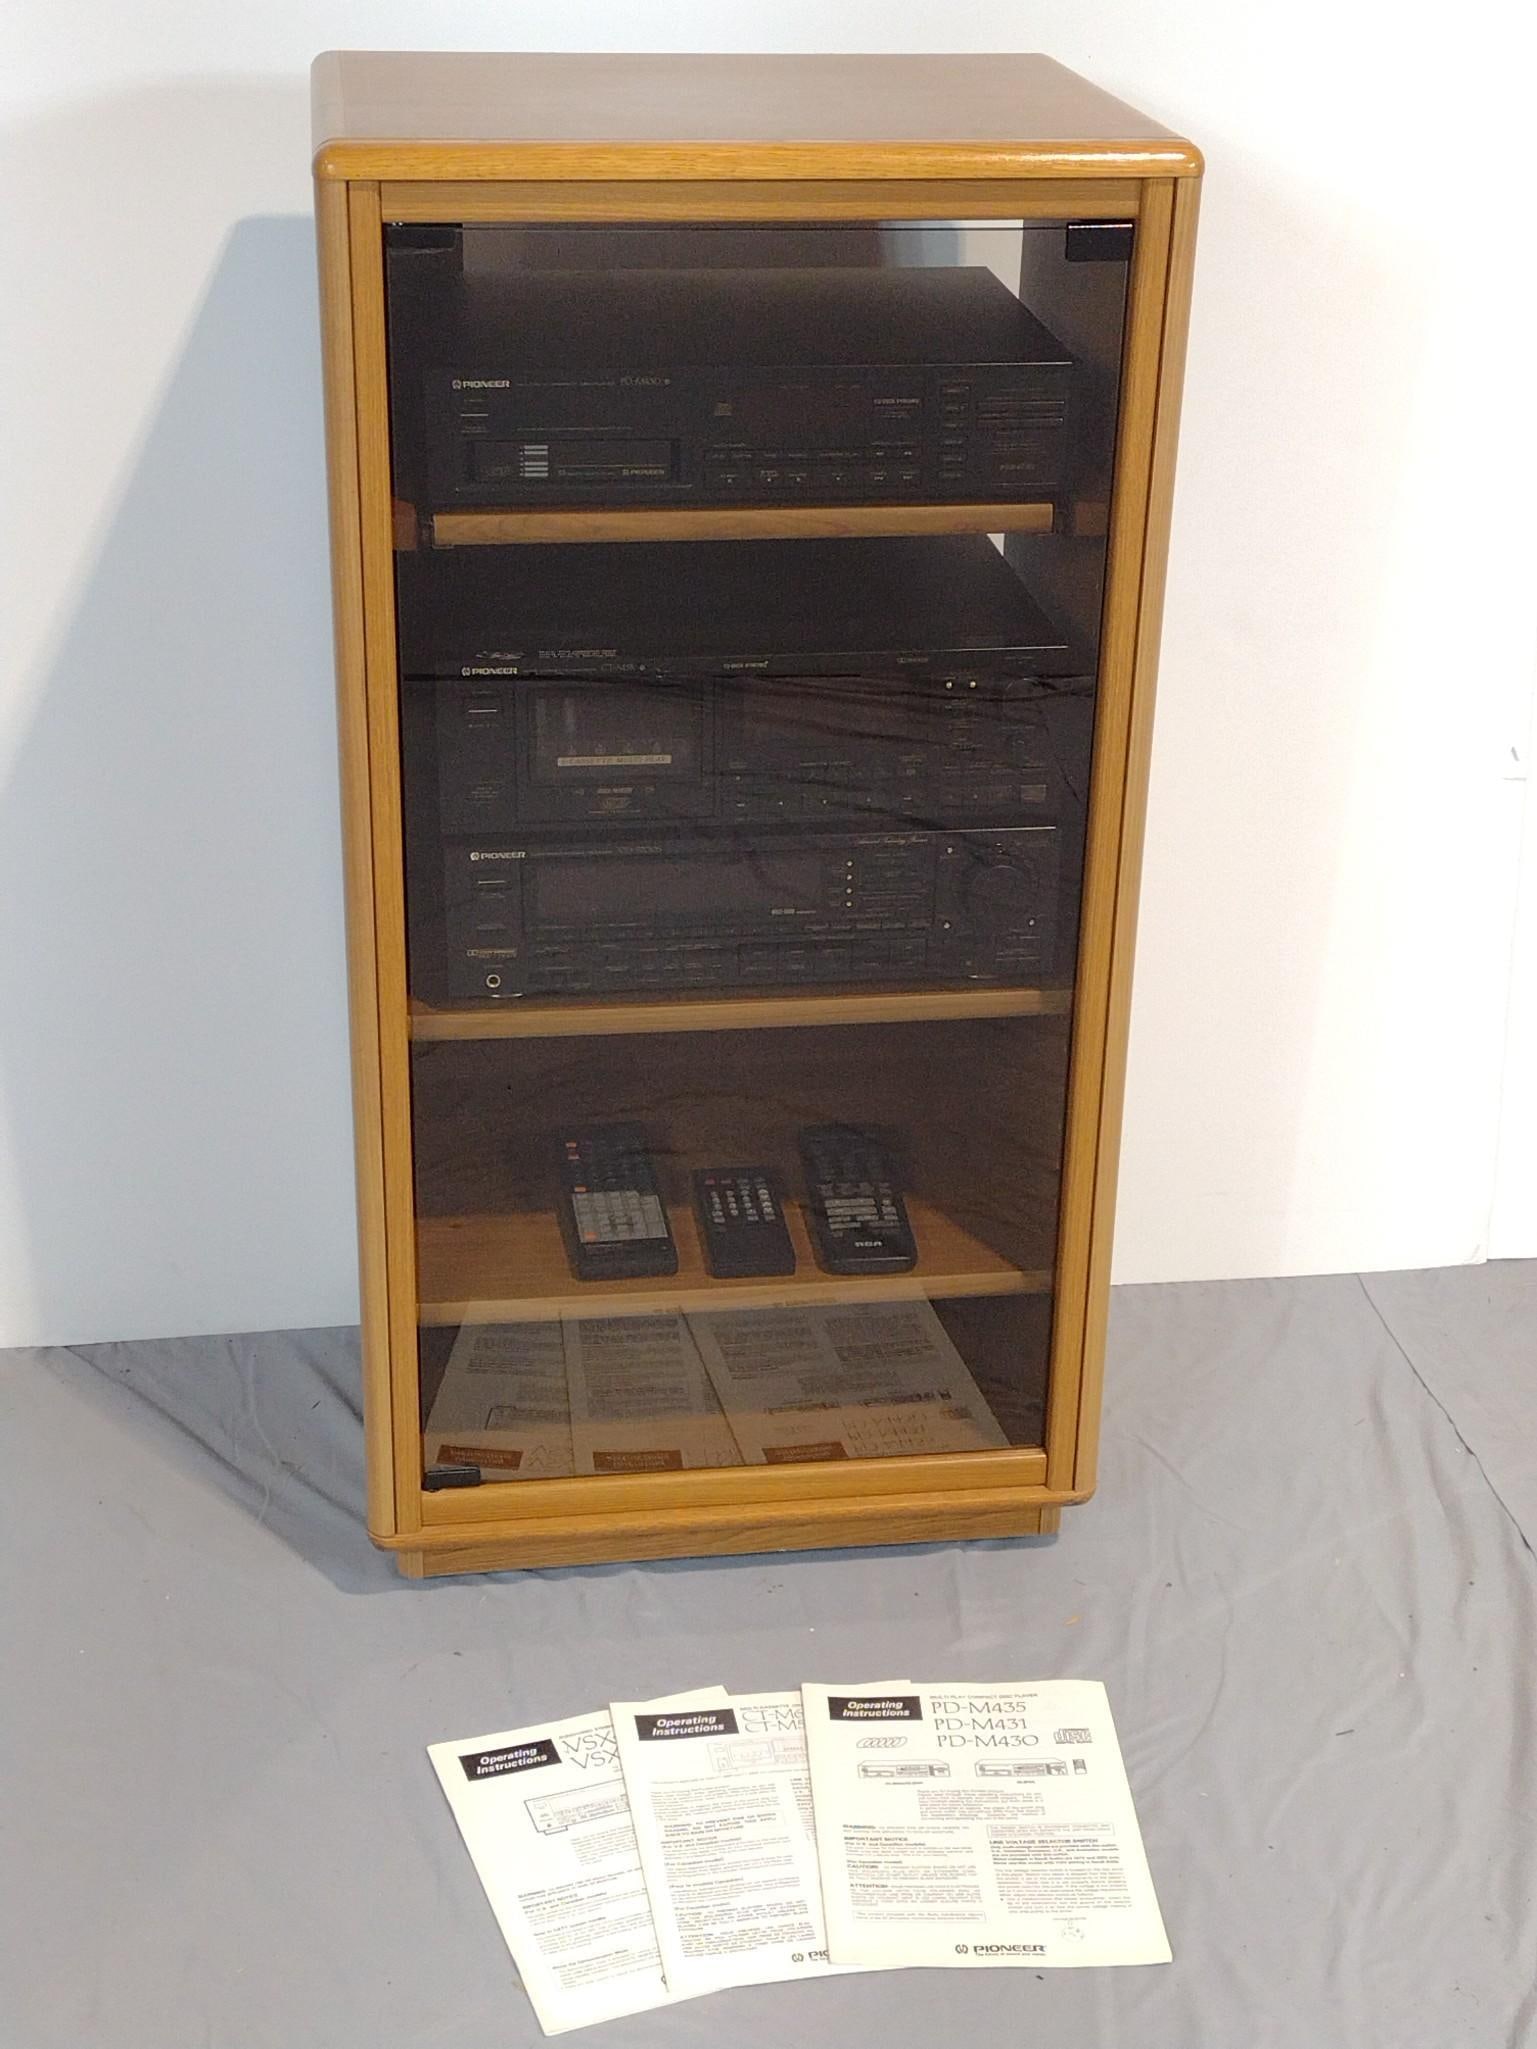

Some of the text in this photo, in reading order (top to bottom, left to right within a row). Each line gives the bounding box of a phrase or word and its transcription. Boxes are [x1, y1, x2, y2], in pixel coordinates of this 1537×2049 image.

[462, 379, 512, 389] PIONEER
[471, 666, 518, 675] PIONEER
[480, 851, 527, 860] PIONEER
[847, 1701, 904, 1710] Operating
[931, 1701, 1027, 1714] PD-M435
[842, 1709, 911, 1717] Instructions
[656, 1715, 717, 1728] Operating
[934, 1718, 1027, 1731] PD-M431
[652, 1723, 725, 1737] Instructions
[937, 1734, 1039, 1748] PD-M430
[480, 1748, 538, 1765] Operating
[476, 1753, 548, 1775] Instructions
[973, 1944, 1047, 1953] PIONEER
